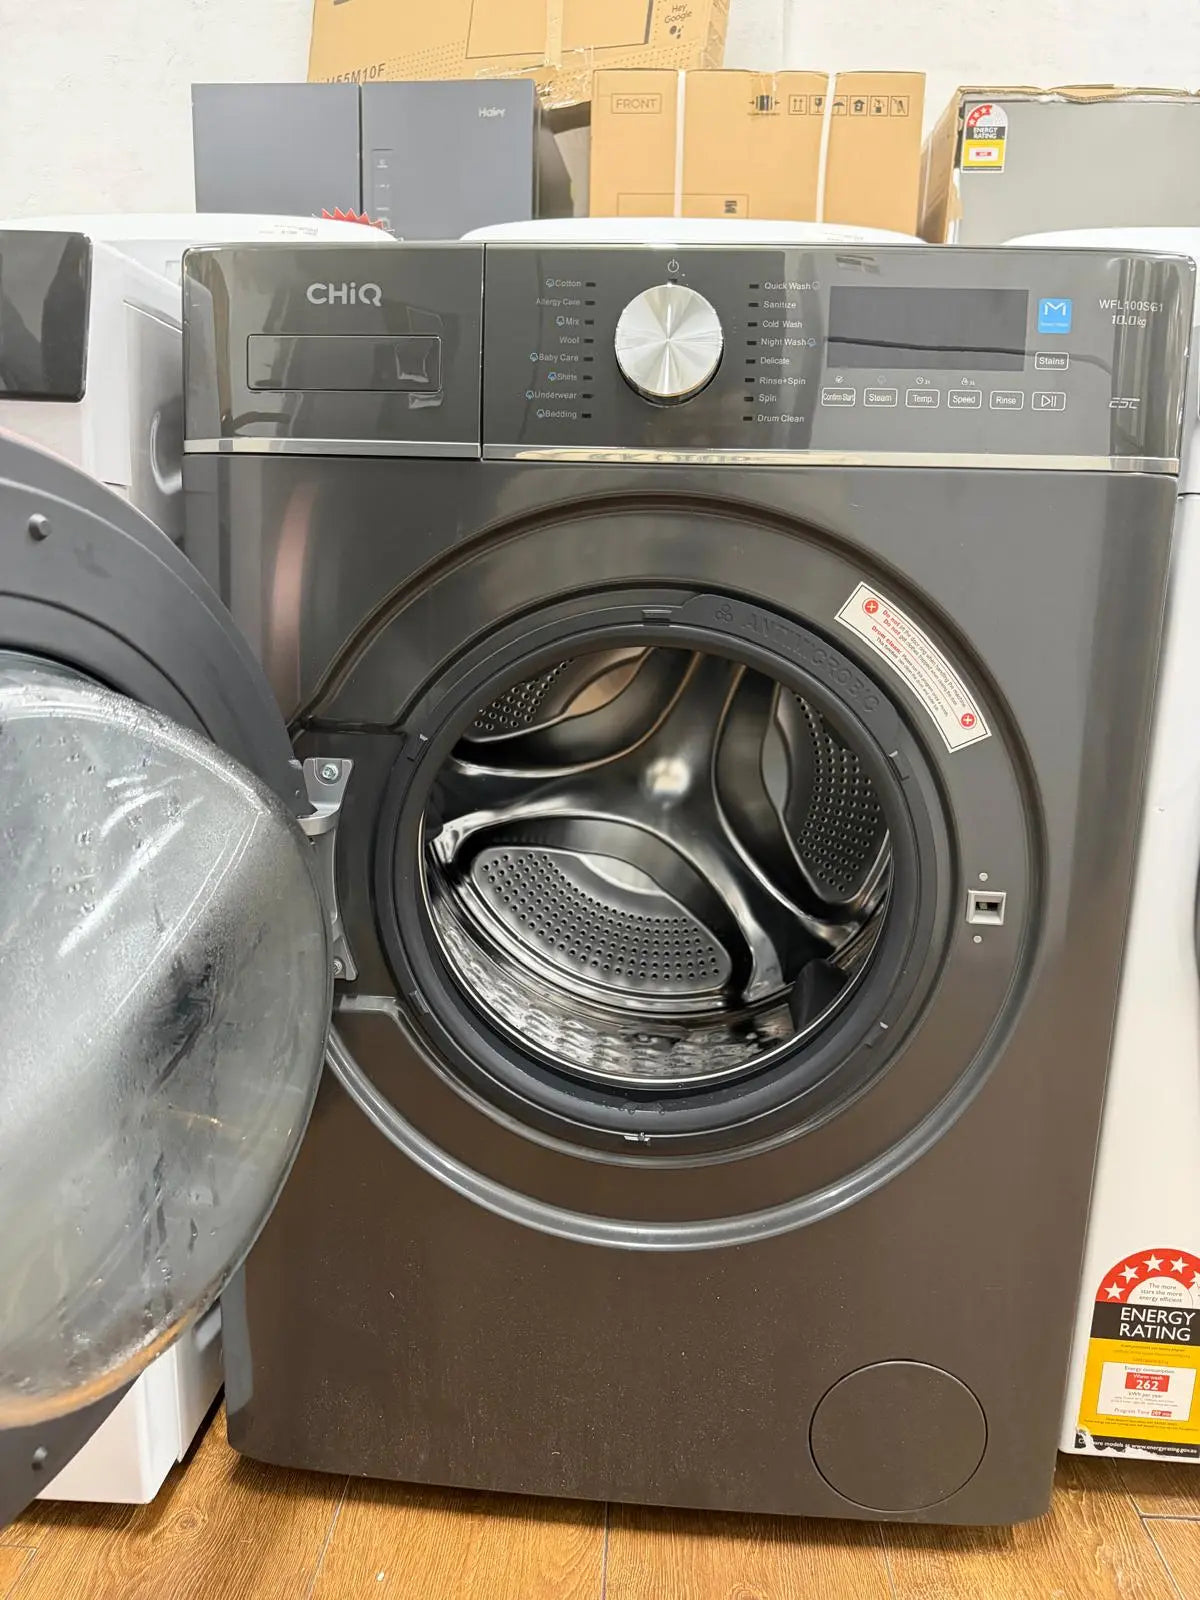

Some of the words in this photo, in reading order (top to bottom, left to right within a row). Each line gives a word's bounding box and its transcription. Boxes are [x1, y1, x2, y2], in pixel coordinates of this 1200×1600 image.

[672, 4, 688, 13] Hey
[664, 11, 692, 23] Google
[615, 98, 657, 109] FRONT
[478, 107, 506, 118] Haier
[554, 279, 582, 288] Cotton
[764, 282, 787, 290] Quick
[788, 282, 811, 290] Wash
[306, 282, 382, 307] CHiQ
[536, 298, 560, 307] Allergy
[562, 298, 581, 306] Care
[763, 300, 797, 309] Sanitize
[1099, 299, 1163, 312] WFL100SG1
[565, 317, 580, 326] Mix
[763, 320, 779, 328] Cold
[782, 320, 803, 328] Wash
[560, 336, 580, 344] Wool
[760, 338, 783, 347] Night
[784, 338, 807, 346] Wash
[538, 353, 558, 363] Baby
[560, 353, 579, 362] Care
[760, 357, 790, 365] Delicate
[1039, 356, 1065, 365] Stains
[557, 373, 578, 381] Shirts
[760, 377, 806, 387] Rinse+Spin
[534, 391, 577, 399] Underwear
[759, 394, 777, 404] Spin
[868, 393, 892, 402] Steam
[952, 395, 976, 404] Speed
[995, 396, 1017, 405] Rinse
[545, 409, 577, 419] Bedding
[757, 414, 779, 422] Drum
[780, 414, 805, 422] Clean
[890, 617, 899, 625] not
[883, 618, 891, 626] Do
[891, 626, 900, 635] not
[871, 625, 885, 639] Drum
[1120, 1307, 1196, 1325] ENERGY
[1119, 1323, 1191, 1341] RATING
[1125, 1365, 1141, 1373] Energy
[1136, 1379, 1159, 1390] 262
[1104, 1441, 1124, 1449] models
[1131, 1443, 1197, 1454] www.energyrating.gov.au
